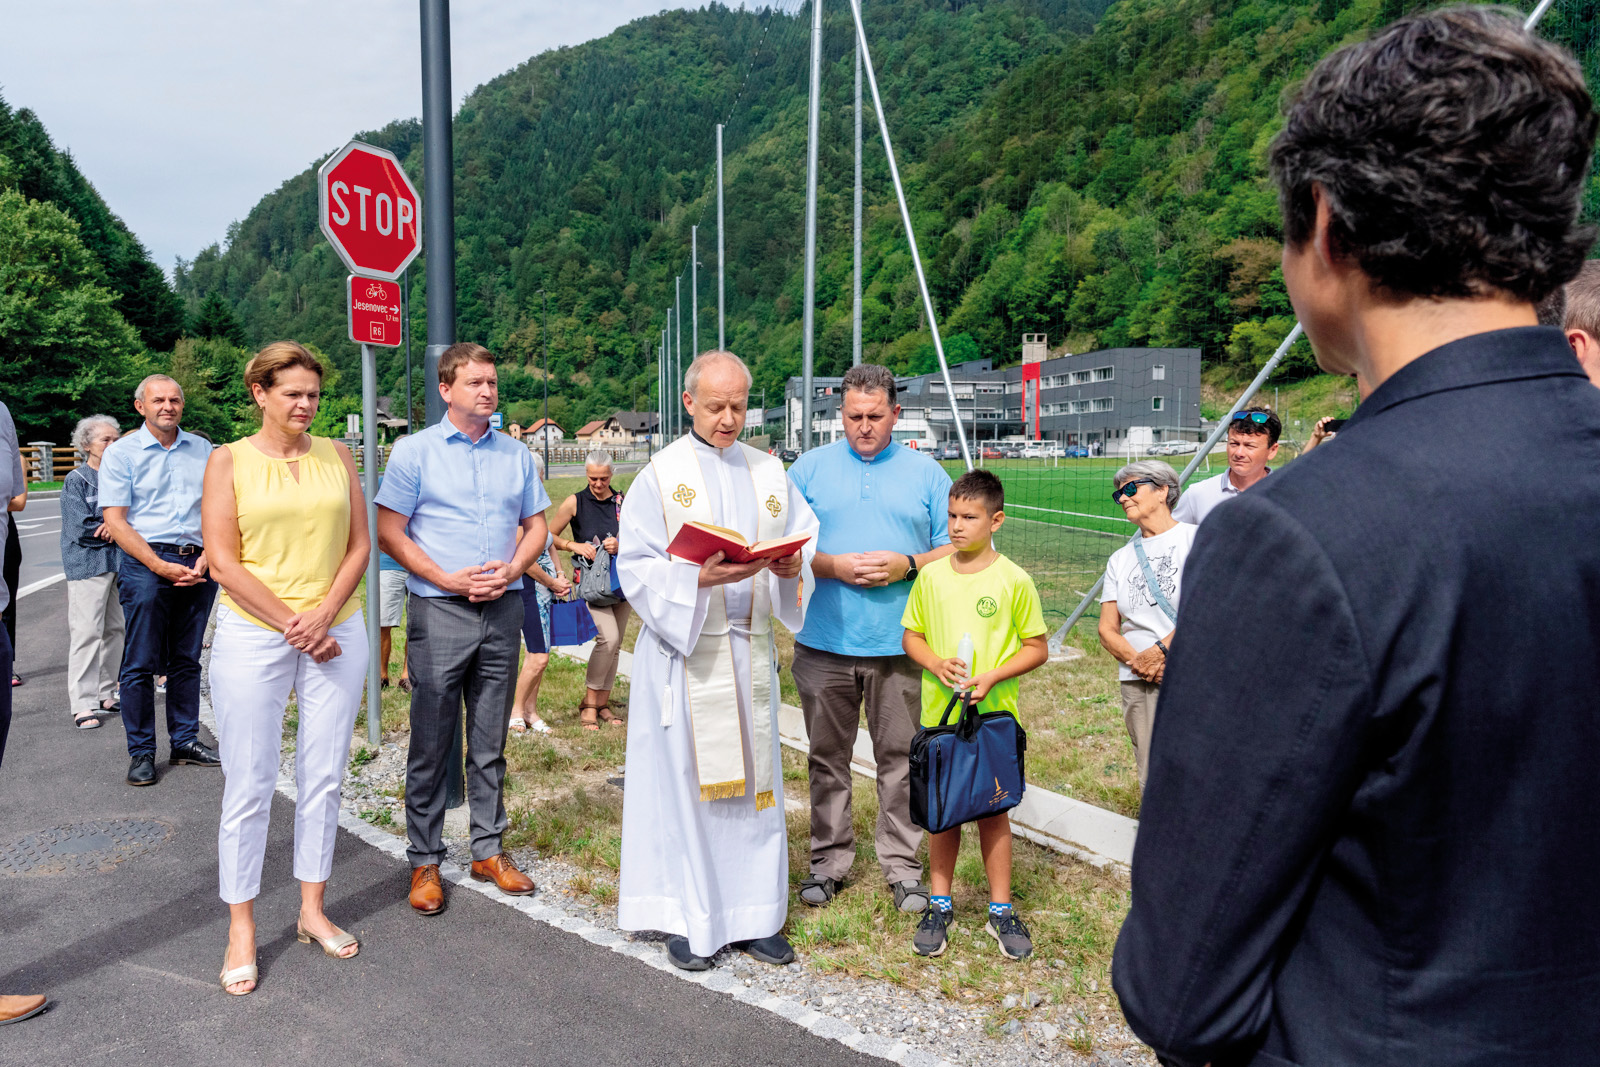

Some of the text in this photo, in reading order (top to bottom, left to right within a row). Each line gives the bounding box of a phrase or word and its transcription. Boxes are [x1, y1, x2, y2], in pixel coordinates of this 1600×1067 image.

[331, 180, 414, 240] STOP
[353, 299, 388, 313] Jesenovec
[373, 326, 382, 336] R6
